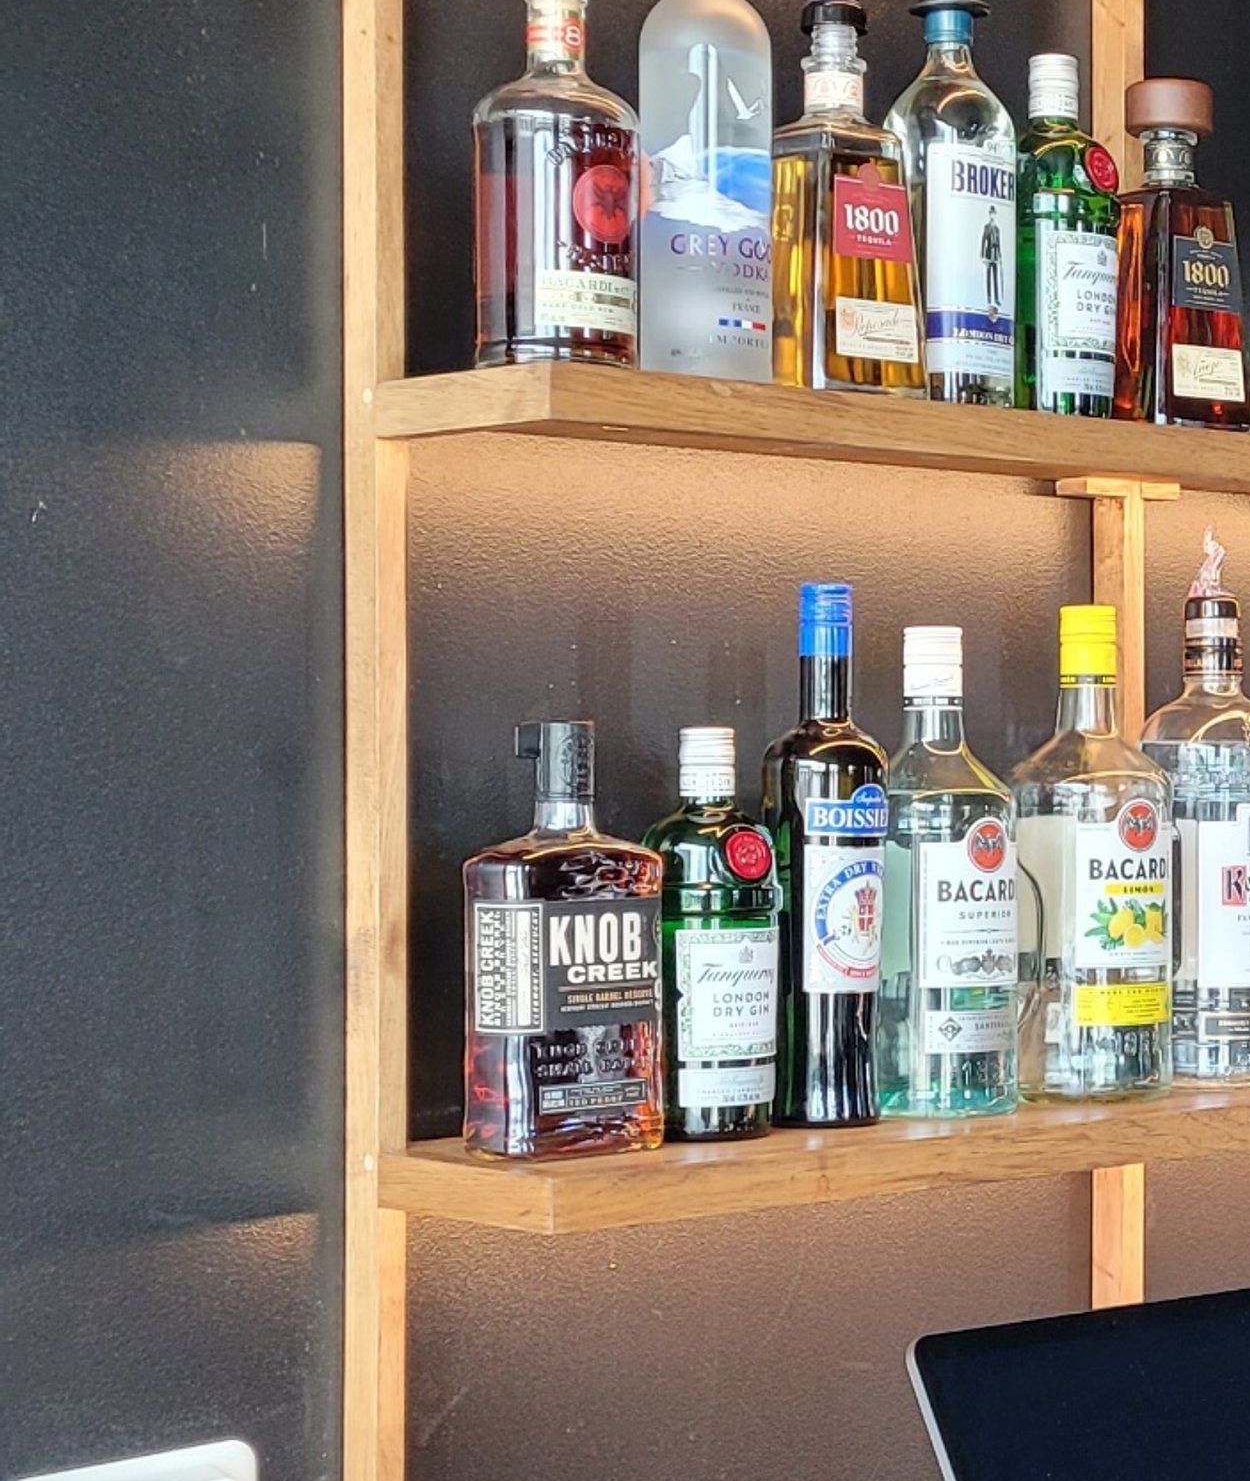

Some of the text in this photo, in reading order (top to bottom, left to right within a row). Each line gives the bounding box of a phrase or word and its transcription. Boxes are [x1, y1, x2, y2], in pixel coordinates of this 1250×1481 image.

[564, 25, 581, 48] 8
[843, 202, 900, 236] 1800
[670, 233, 730, 256] GREY
[856, 233, 892, 247] TEQUILA
[1182, 259, 1229, 289] 1800
[1076, 301, 1101, 315] DRY
[959, 909, 1012, 920] SUPERIOR
[550, 911, 642, 967] KNOB
[480, 910, 494, 1026] KNOB CREEK
[567, 959, 659, 984] CREEK
[713, 991, 770, 1004] LONDON
[713, 1004, 770, 1017] DRY GIN
